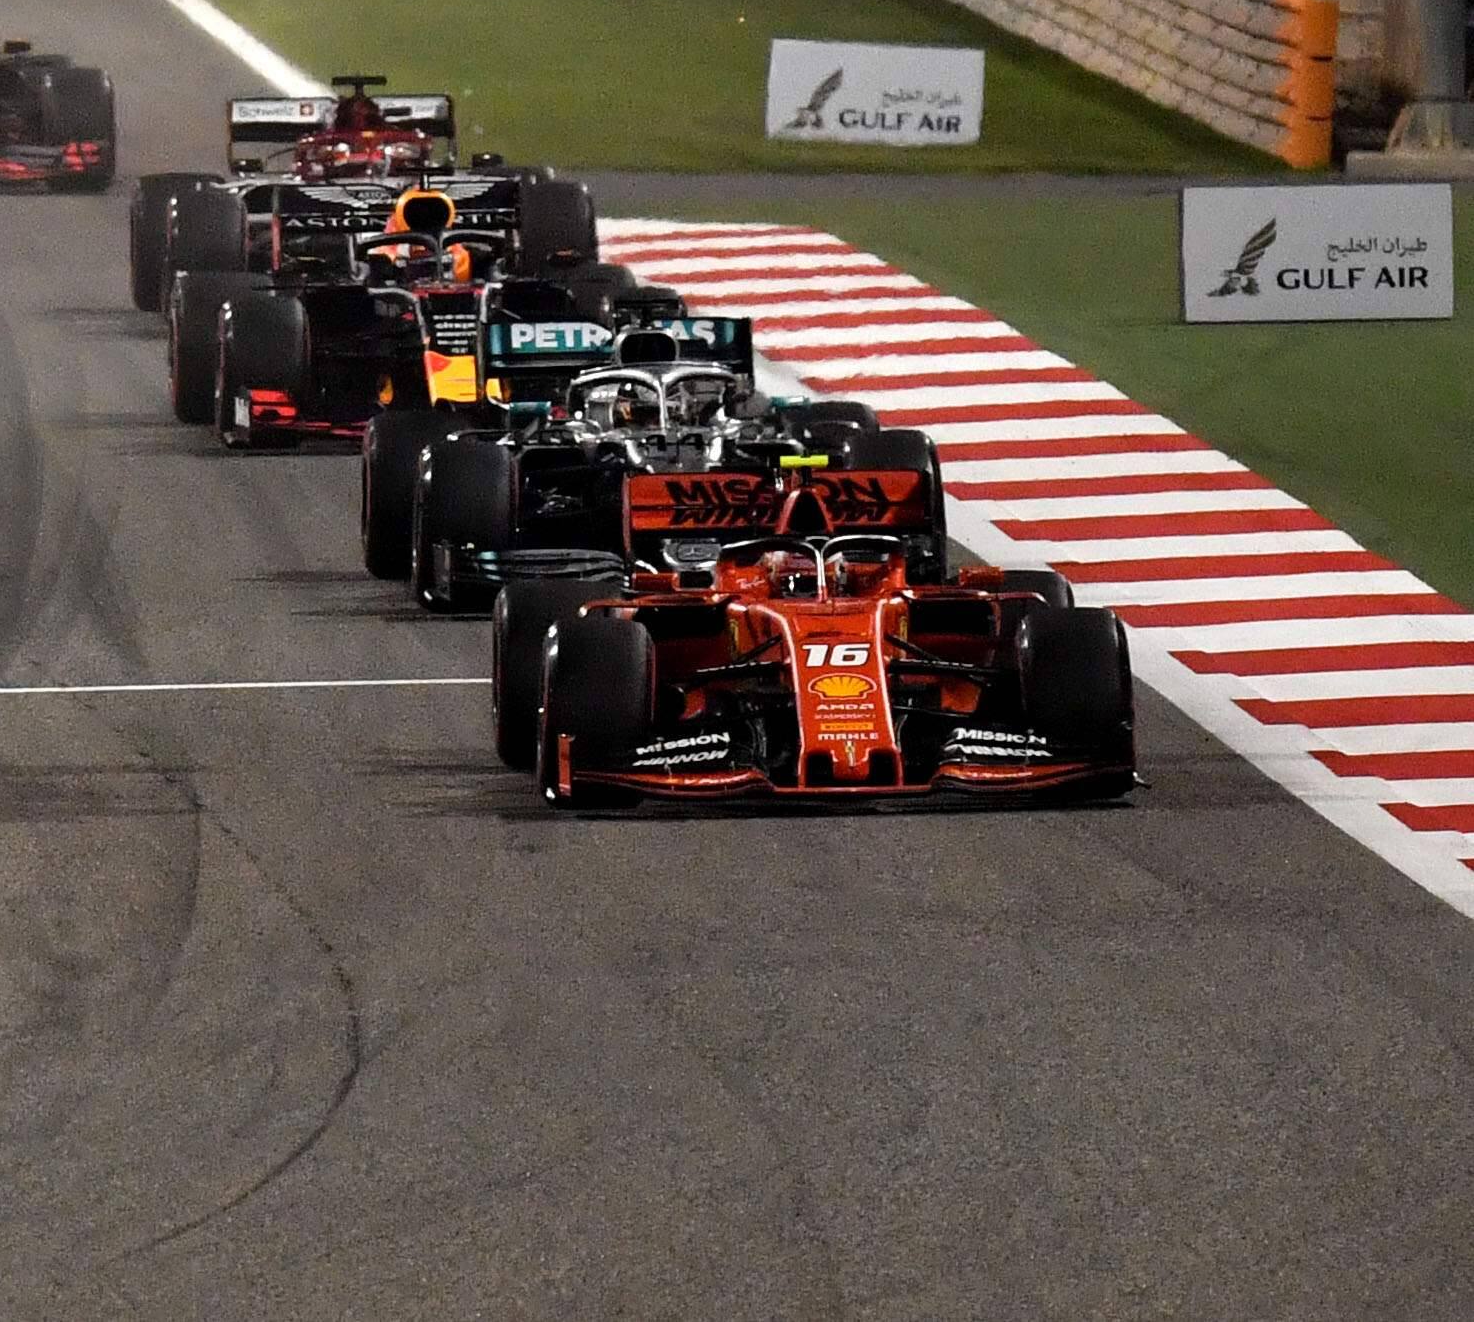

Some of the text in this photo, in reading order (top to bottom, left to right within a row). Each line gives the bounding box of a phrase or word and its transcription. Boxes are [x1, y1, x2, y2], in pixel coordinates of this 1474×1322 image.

[839, 109, 962, 133] GULF AIR
[1326, 236, 1429, 262] طيران الخليج
[1276, 266, 1429, 290] GULF AIR
[801, 643, 871, 668] 16
[636, 732, 731, 755] MISSION
[953, 727, 1047, 745] MISSION
